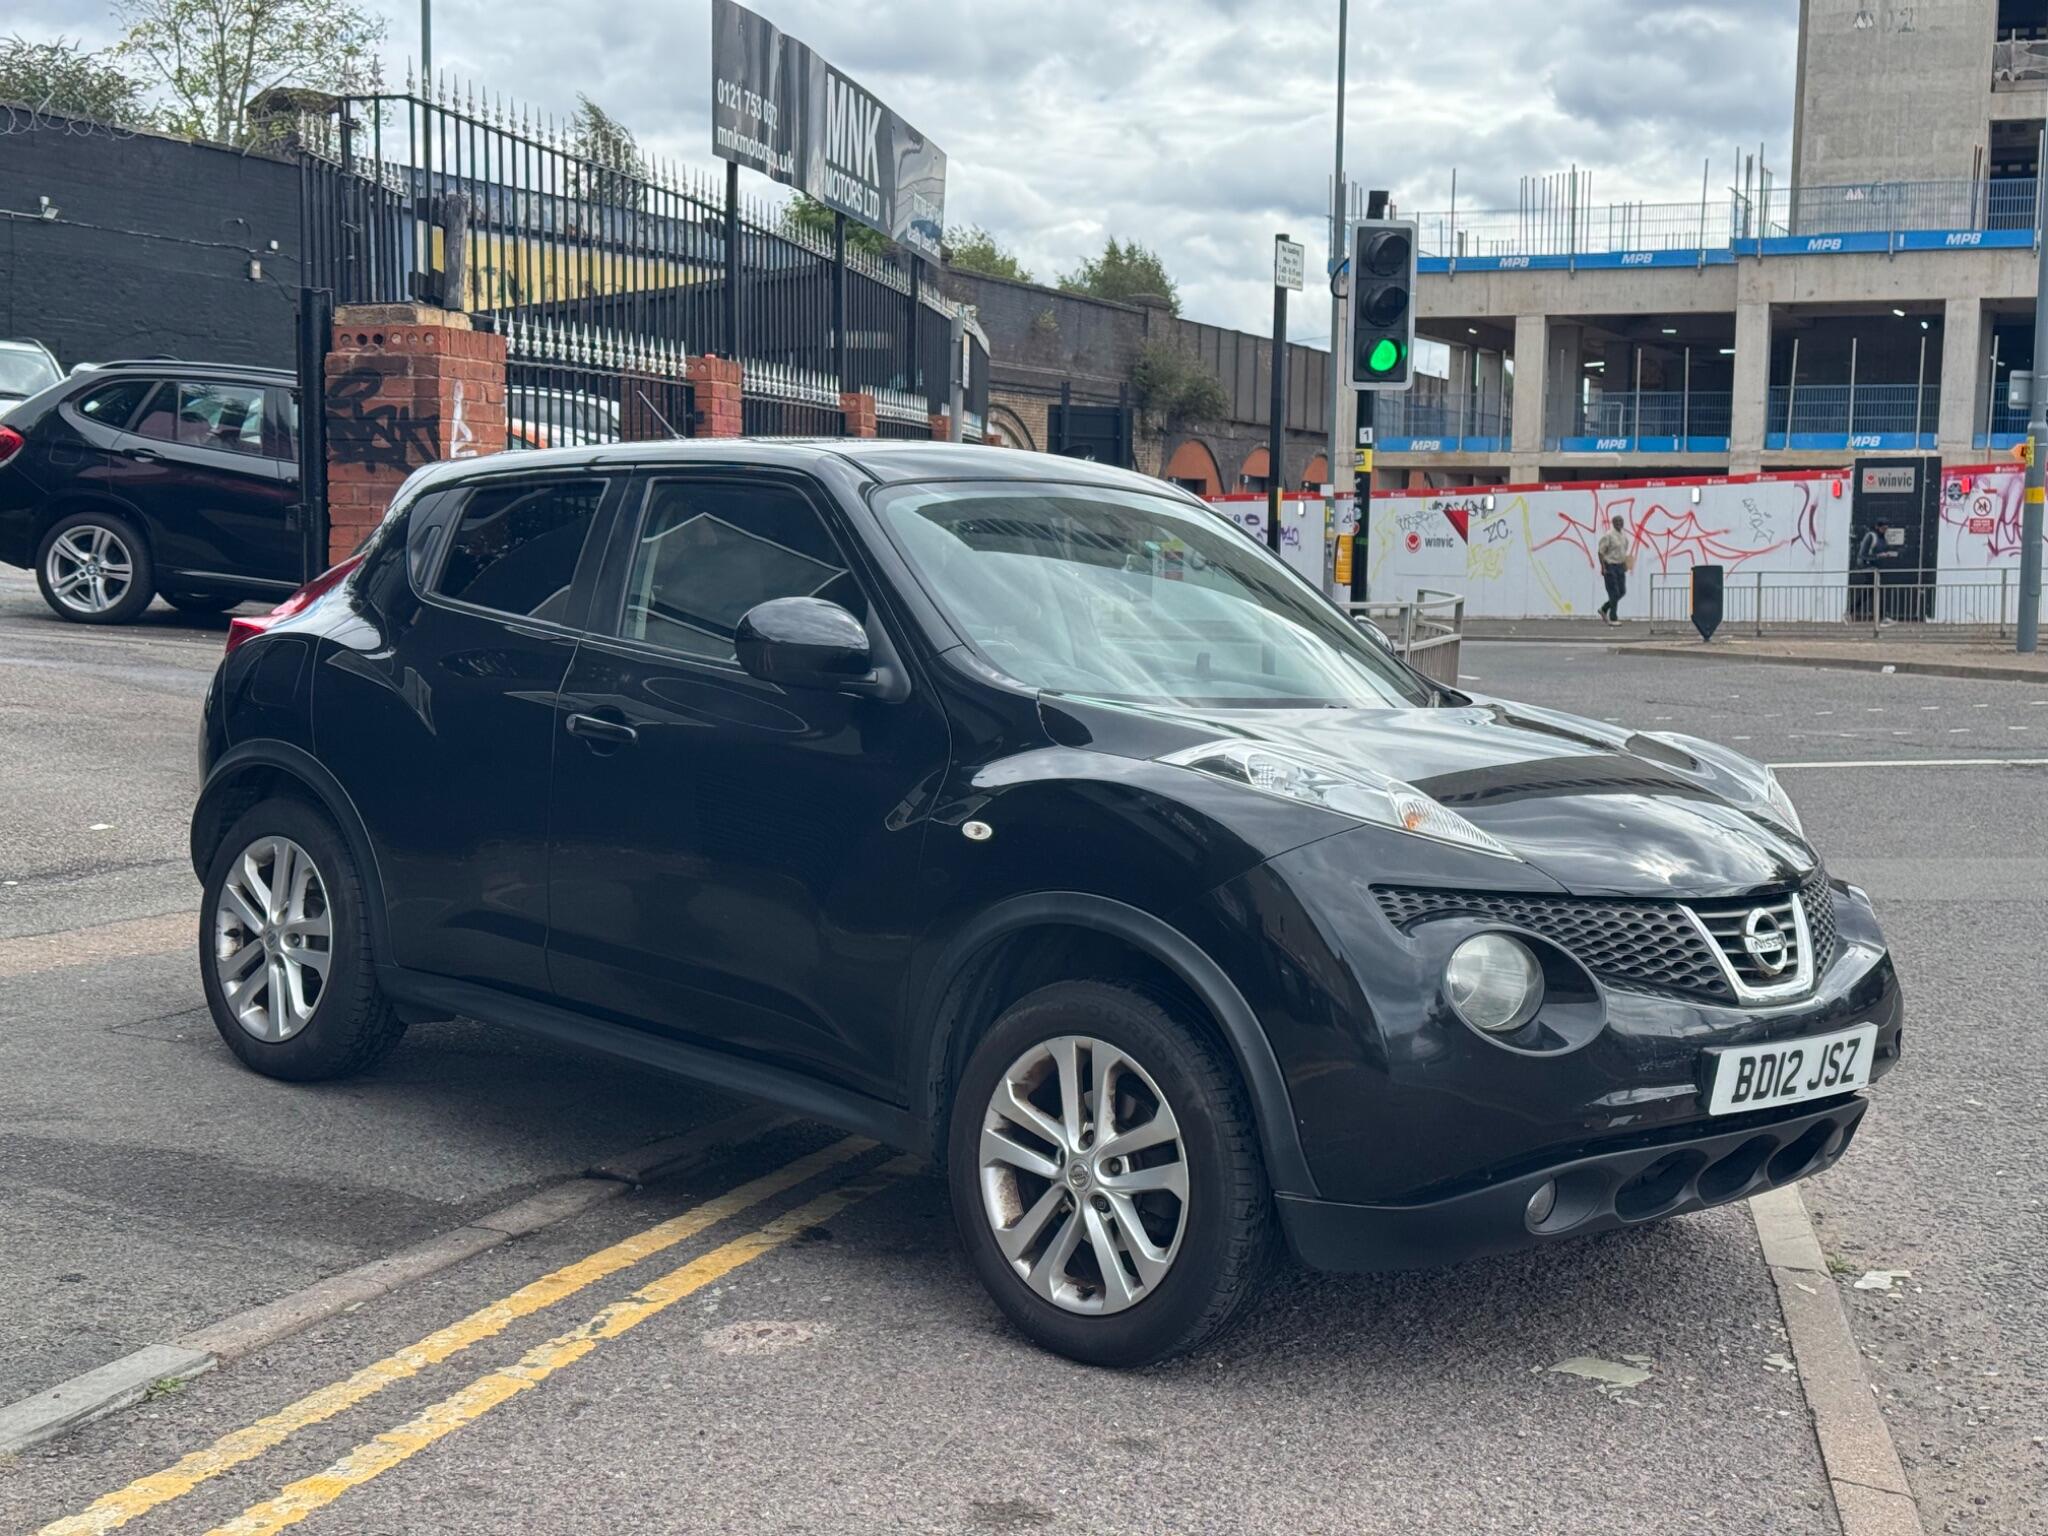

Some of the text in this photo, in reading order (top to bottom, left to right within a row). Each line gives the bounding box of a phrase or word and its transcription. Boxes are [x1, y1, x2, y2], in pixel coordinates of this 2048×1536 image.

[717, 78, 741, 111] 0121
[744, 90, 762, 120] 753
[826, 72, 882, 188] MNK
[825, 165, 863, 213] MOTORS
[864, 187, 880, 221] LTD
[1807, 238, 1842, 250] MPB
[1945, 233, 1981, 245] MPB
[1499, 257, 1529, 268] MPB
[1621, 253, 1653, 264] MPB
[1410, 440, 1440, 451] MPB
[1596, 439, 1626, 450] MPB
[1847, 435, 1881, 447] MPB
[1878, 472, 1912, 488] winvic
[1424, 533, 1454, 548] winvic
[1731, 1037, 1862, 1104] BD12 JSZ
